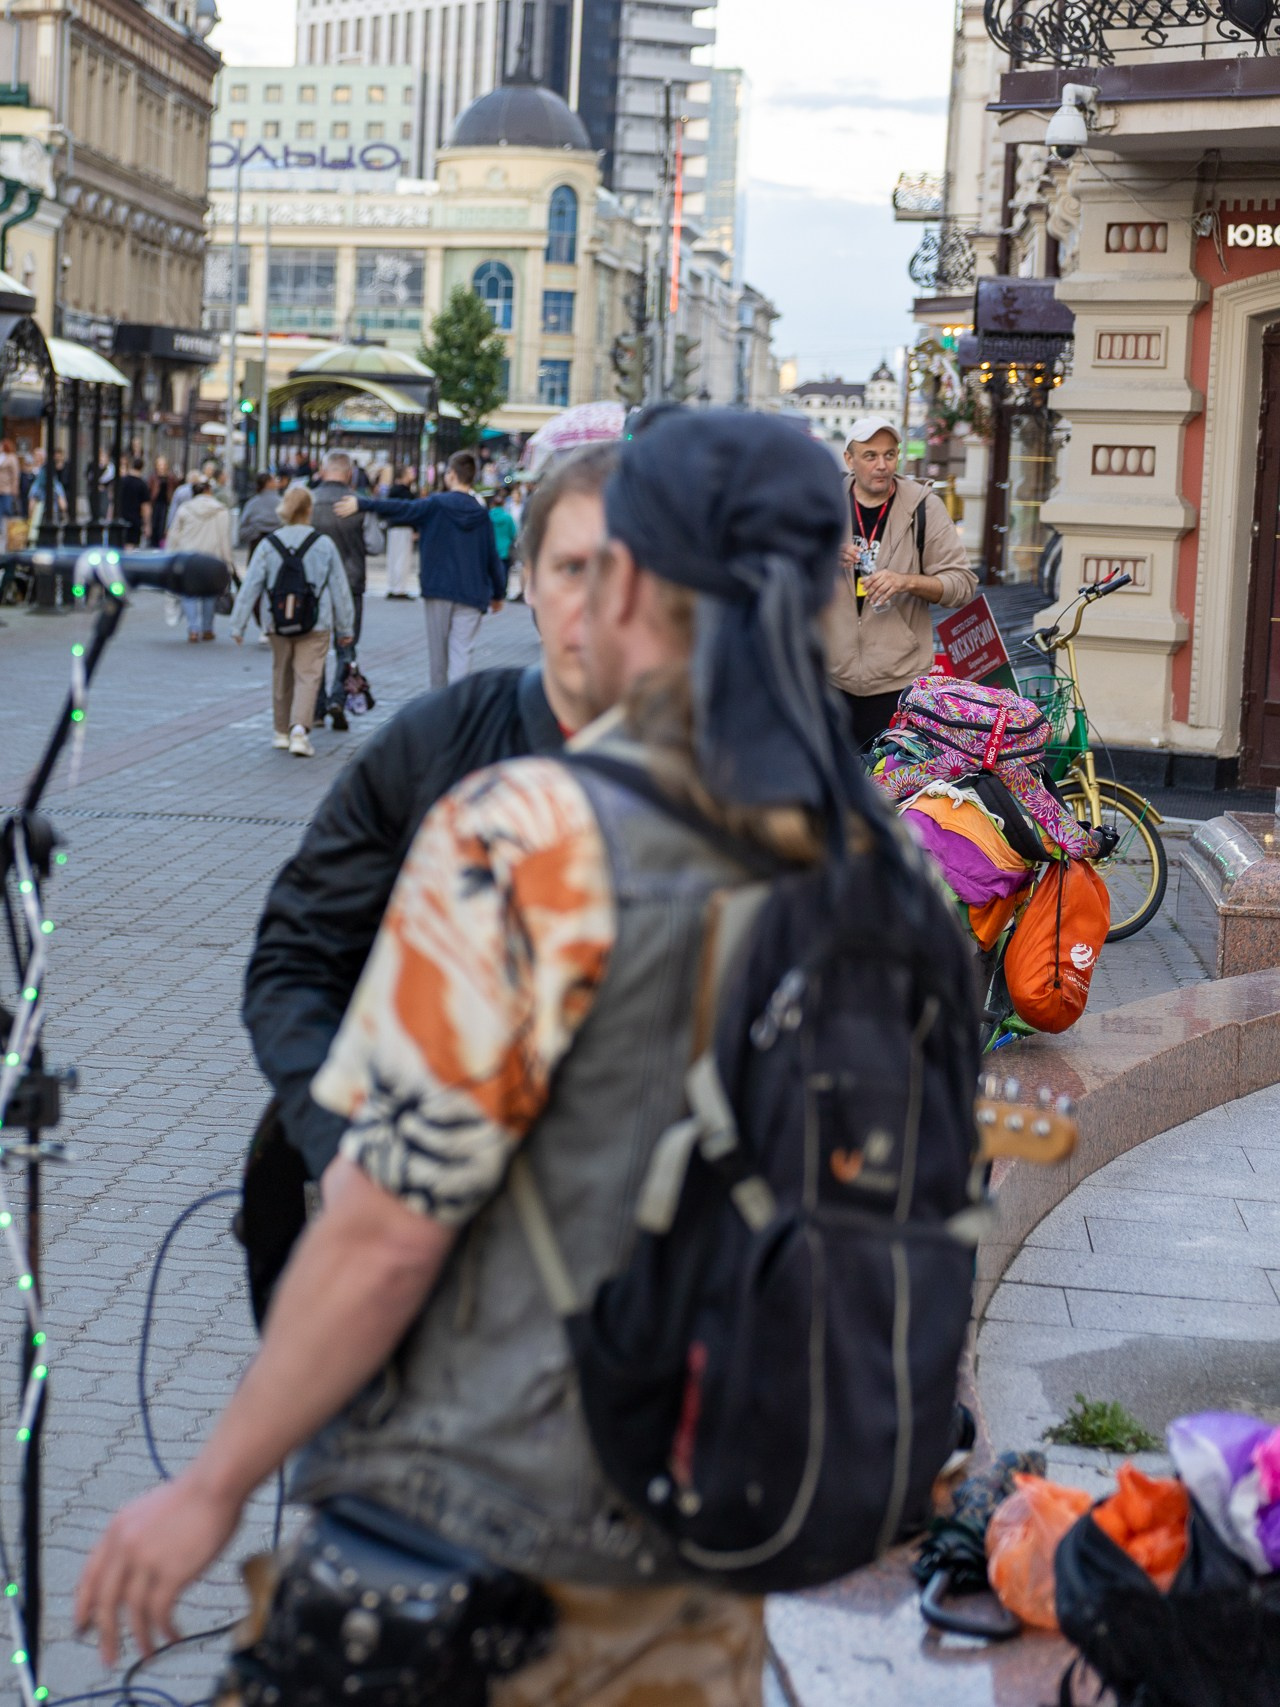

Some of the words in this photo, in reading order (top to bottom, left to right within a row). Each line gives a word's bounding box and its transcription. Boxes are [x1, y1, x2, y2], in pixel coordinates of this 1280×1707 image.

[209, 141, 402, 171] ОЛЬЦО
[946, 618, 996, 664] ЭКСКУРСИИ
[986, 746, 997, 765] CREW
